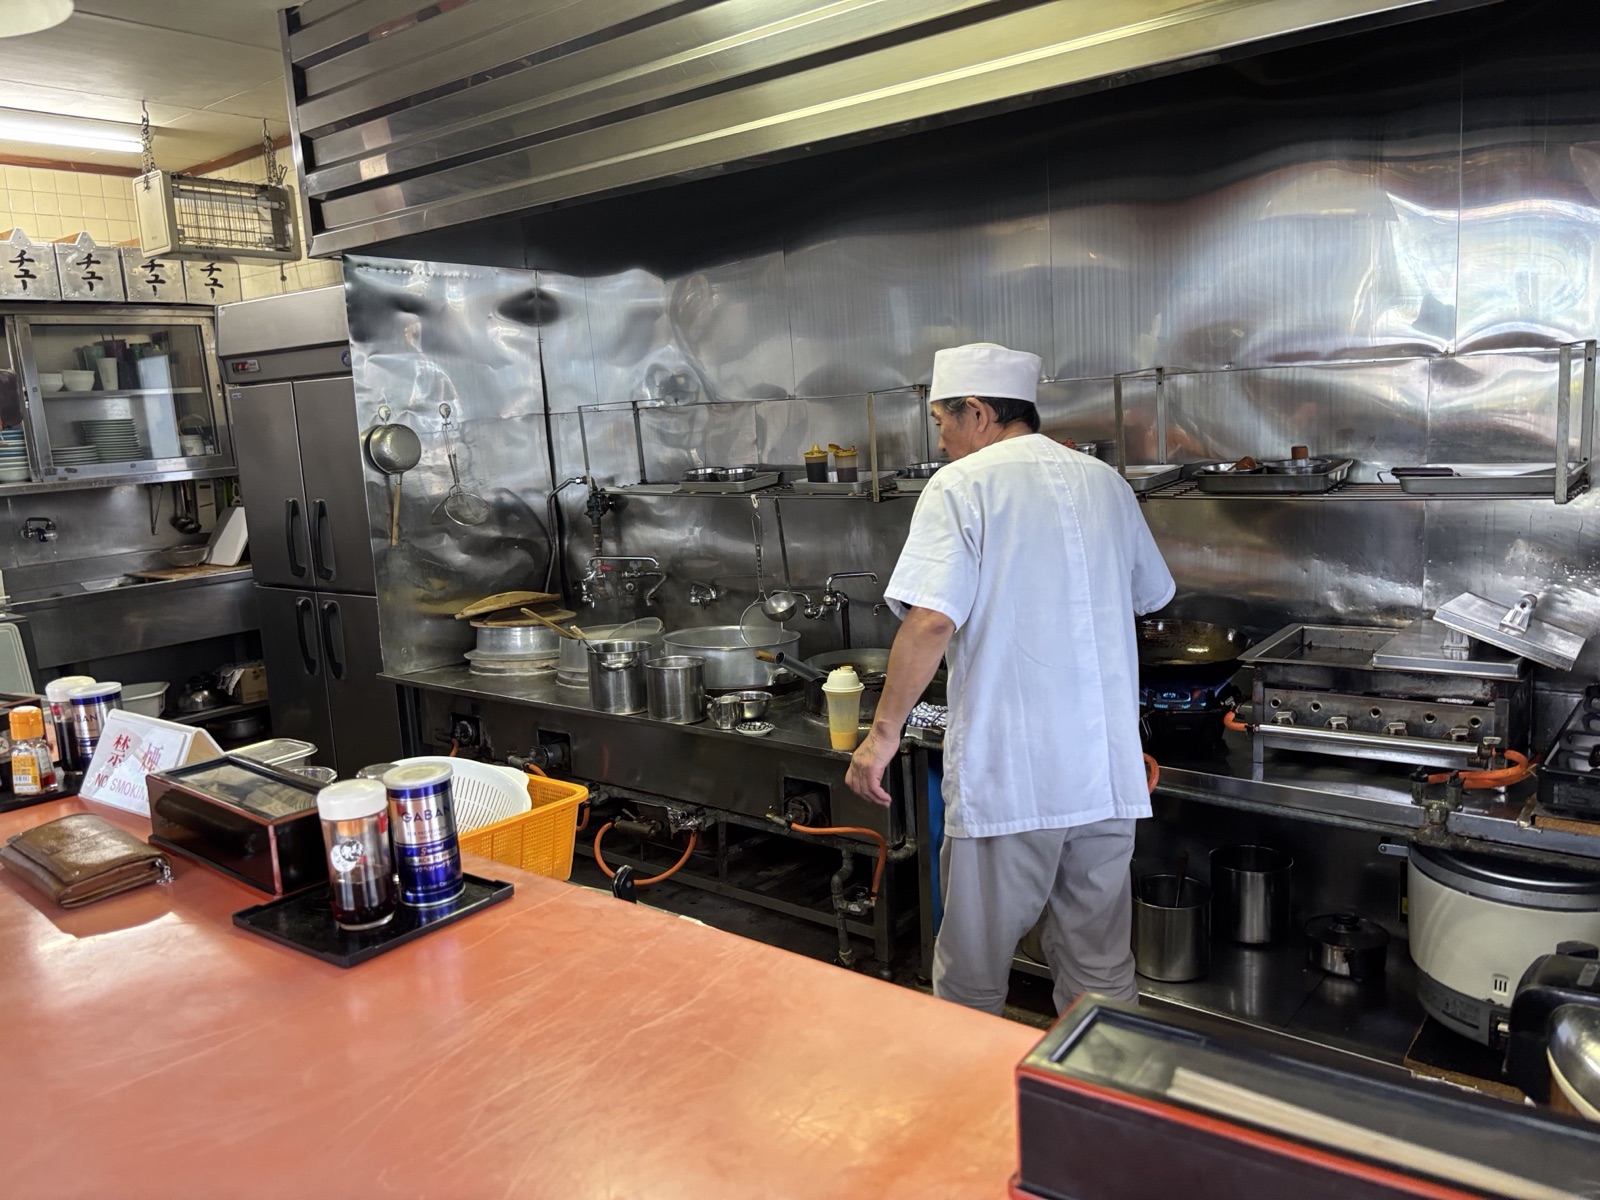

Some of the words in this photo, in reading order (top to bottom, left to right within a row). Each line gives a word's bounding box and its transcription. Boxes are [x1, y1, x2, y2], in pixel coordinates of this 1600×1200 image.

[94, 773, 109, 789] NO
[110, 778, 150, 803] SMOKIN
[402, 805, 449, 822] GABAN
